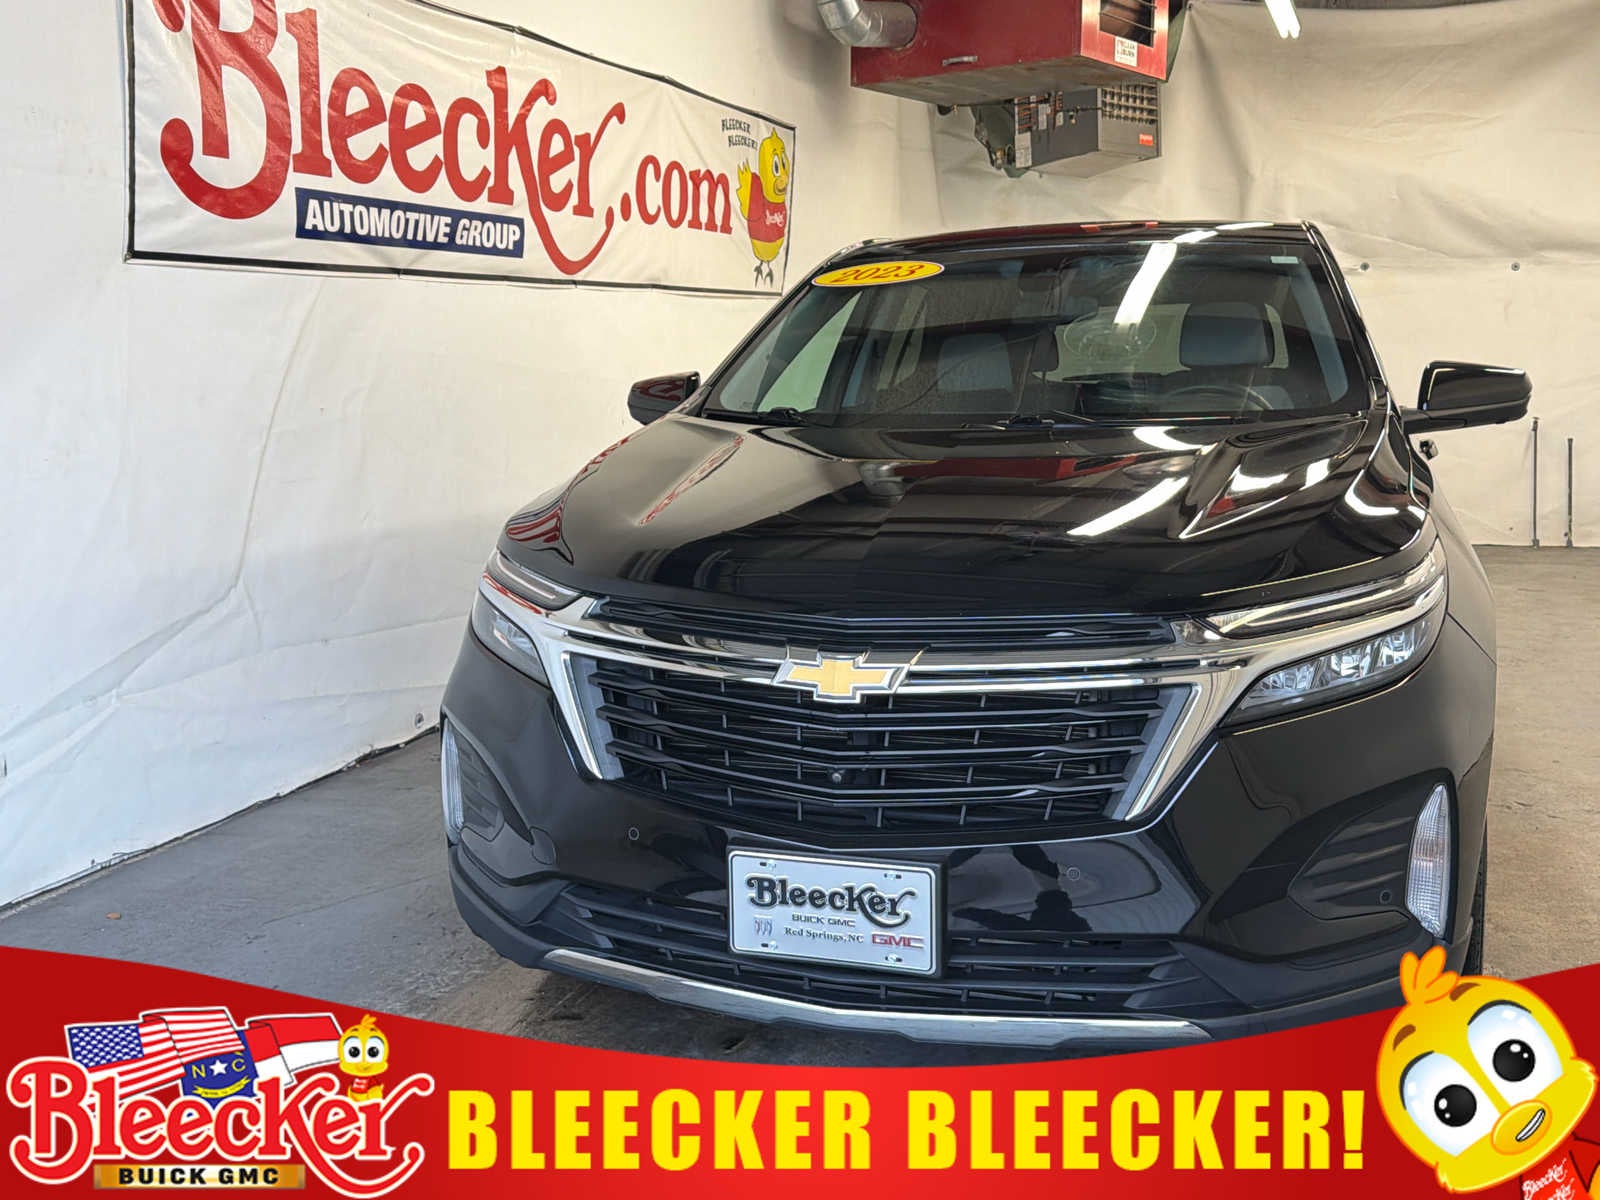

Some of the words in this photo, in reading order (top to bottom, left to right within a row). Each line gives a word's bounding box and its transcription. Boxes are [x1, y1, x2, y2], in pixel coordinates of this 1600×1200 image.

[304, 199, 452, 243] AUTOMOTIVE
[454, 218, 521, 250] GROUP
[829, 264, 926, 283] 2023
[791, 913, 824, 925] BUICK
[827, 917, 857, 928] GMC
[784, 926, 804, 938] Red
[871, 932, 926, 949] GMC
